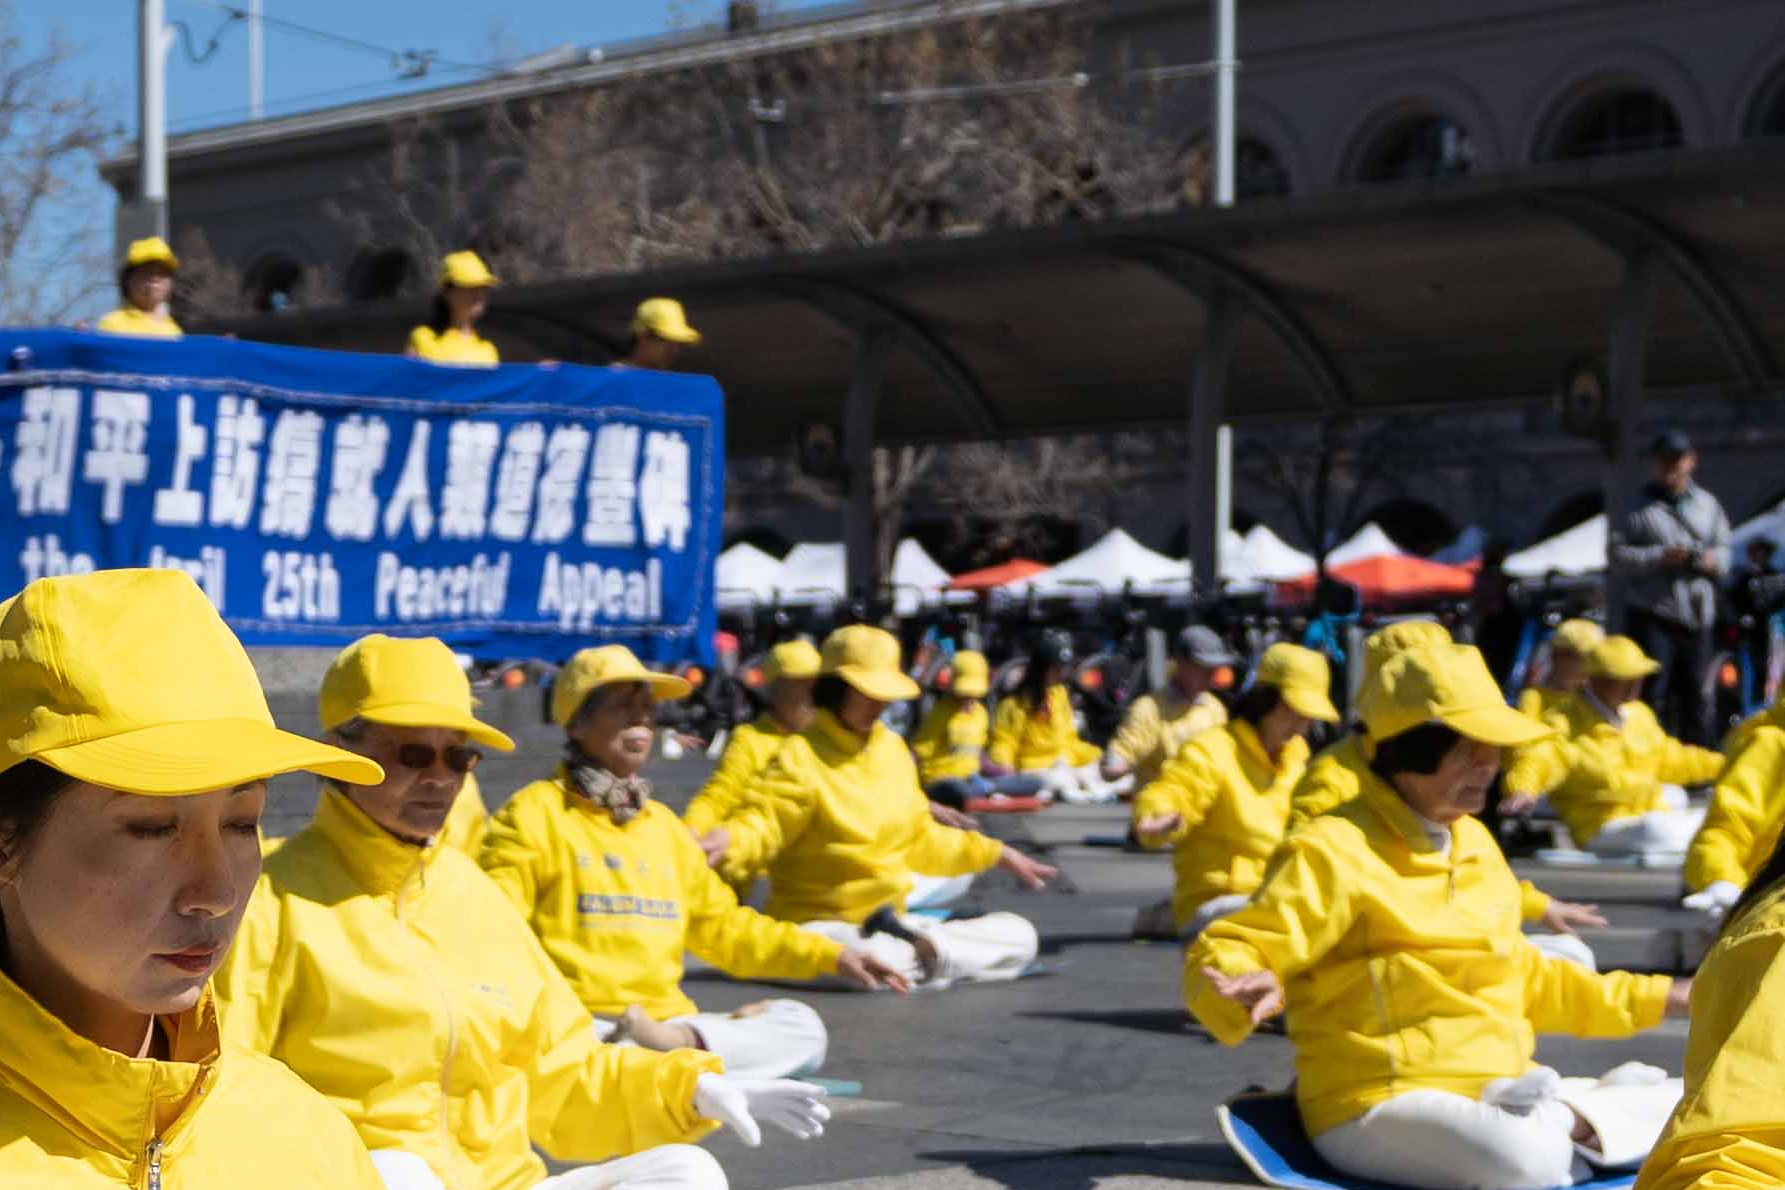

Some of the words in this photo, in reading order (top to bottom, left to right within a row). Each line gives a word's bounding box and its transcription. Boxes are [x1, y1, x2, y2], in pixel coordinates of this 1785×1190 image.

[262, 551, 340, 620] 25th
[374, 551, 511, 618] Peaceful
[538, 551, 661, 631] Appeal
